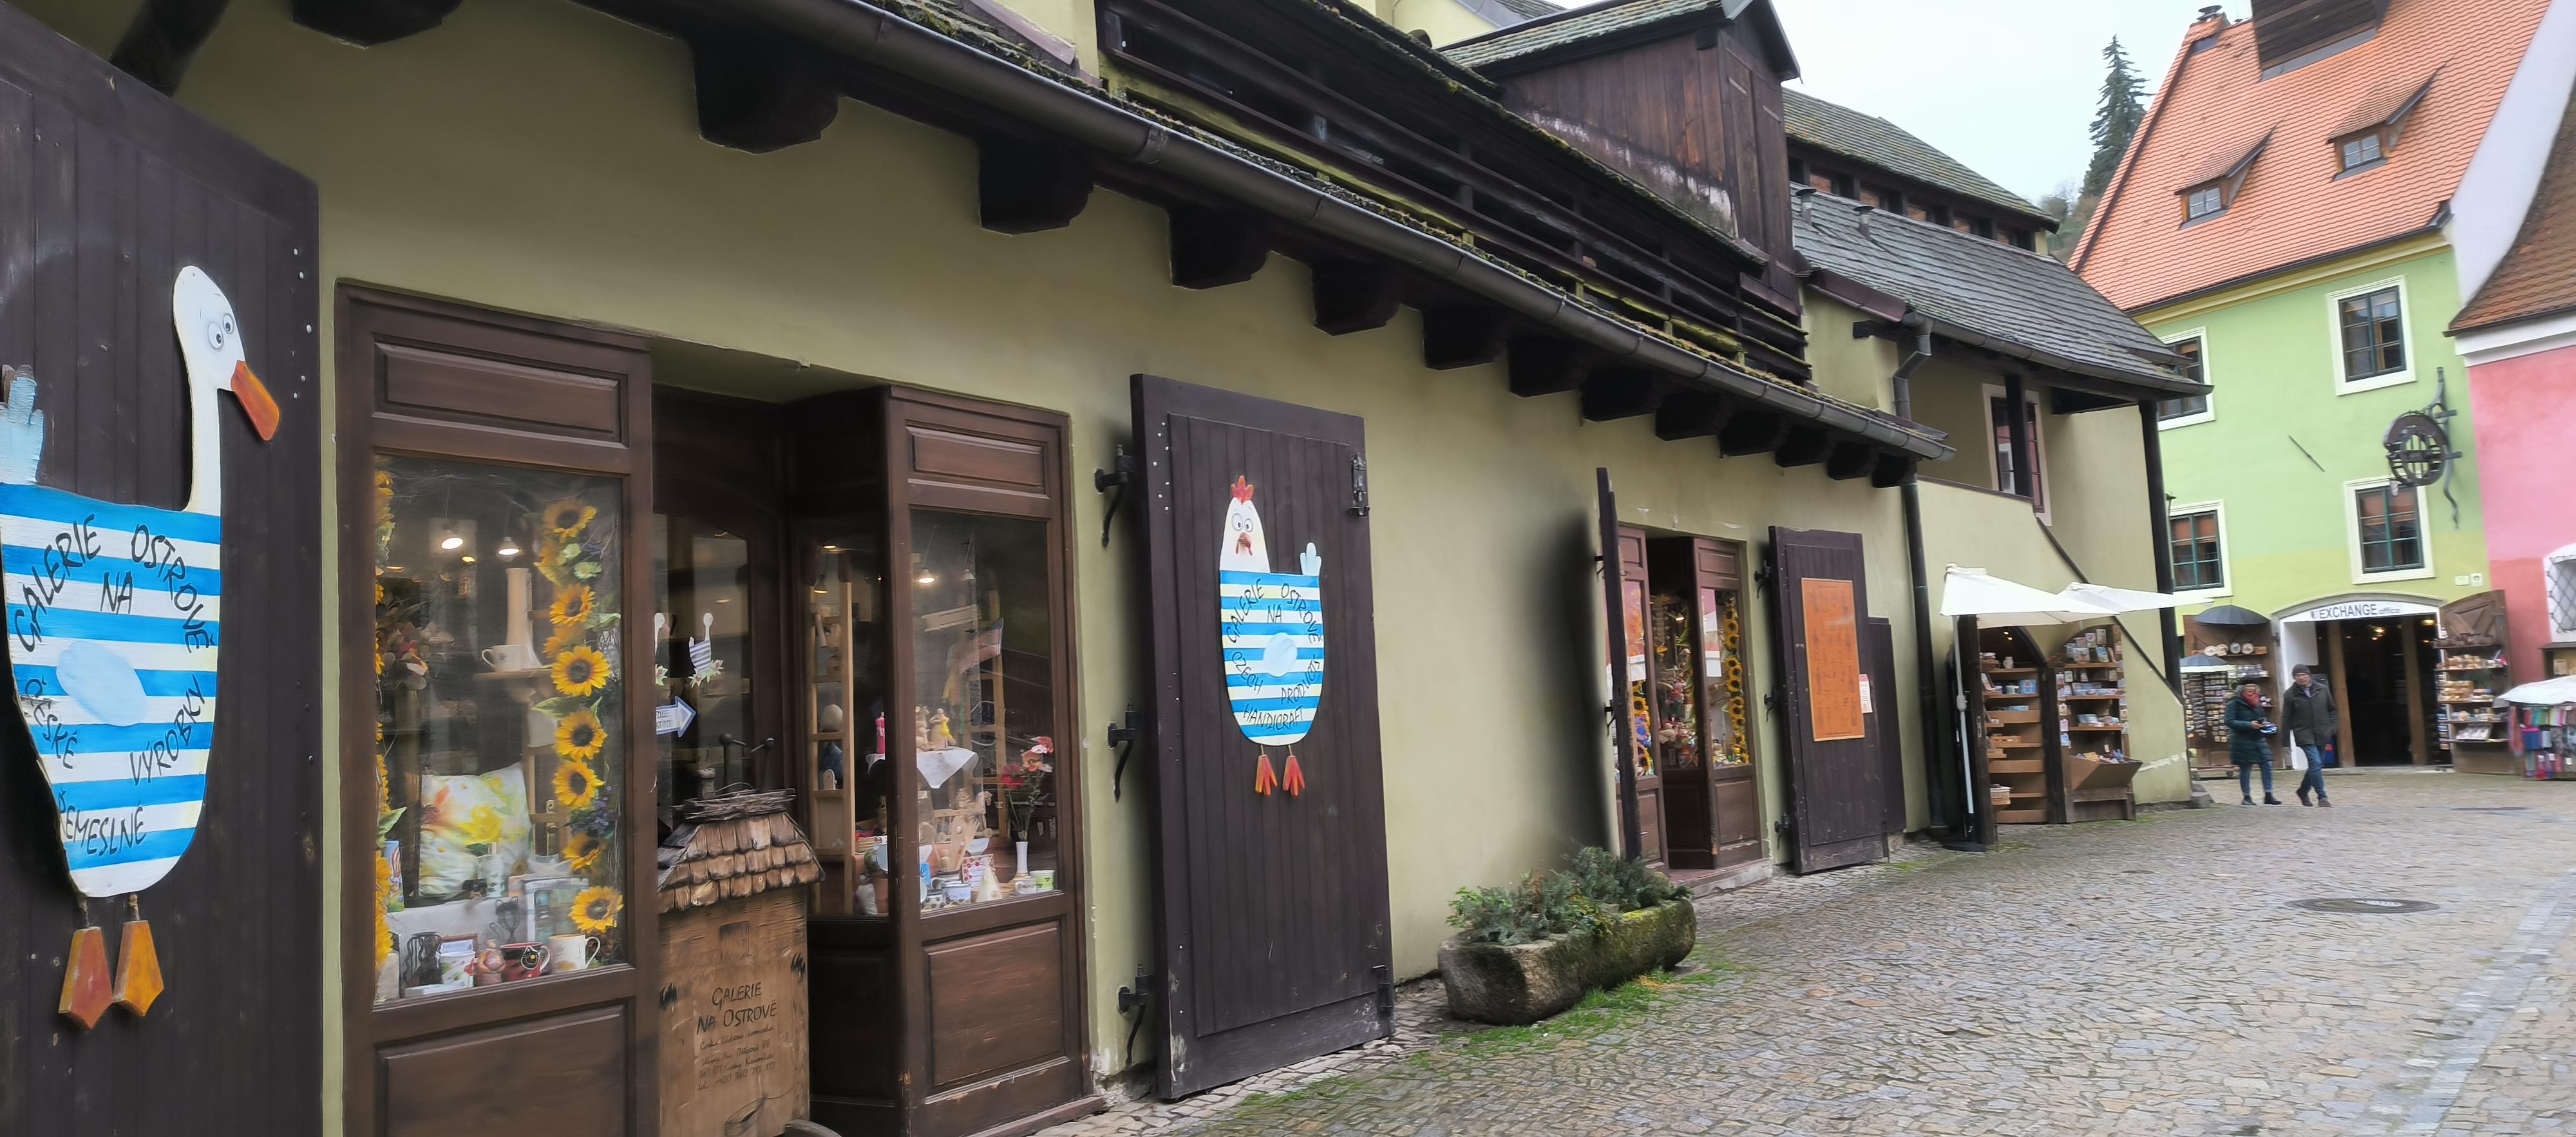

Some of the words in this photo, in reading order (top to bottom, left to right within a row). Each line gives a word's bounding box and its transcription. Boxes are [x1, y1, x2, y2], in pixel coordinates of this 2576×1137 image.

[15, 514, 101, 652] GALERIE
[100, 571, 133, 615] NA
[131, 524, 215, 653] OSTROVĚ
[1226, 578, 1265, 643] GALERIE
[1267, 604, 1282, 624] NA
[2319, 604, 2377, 618] EXCHANGE
[1232, 651, 1264, 694] CZECH
[130, 674, 205, 786] VÝROBKY
[1243, 703, 1303, 731] HANDICRAFT
[712, 982, 762, 1011] GALERIE
[697, 1015, 715, 1035] NA
